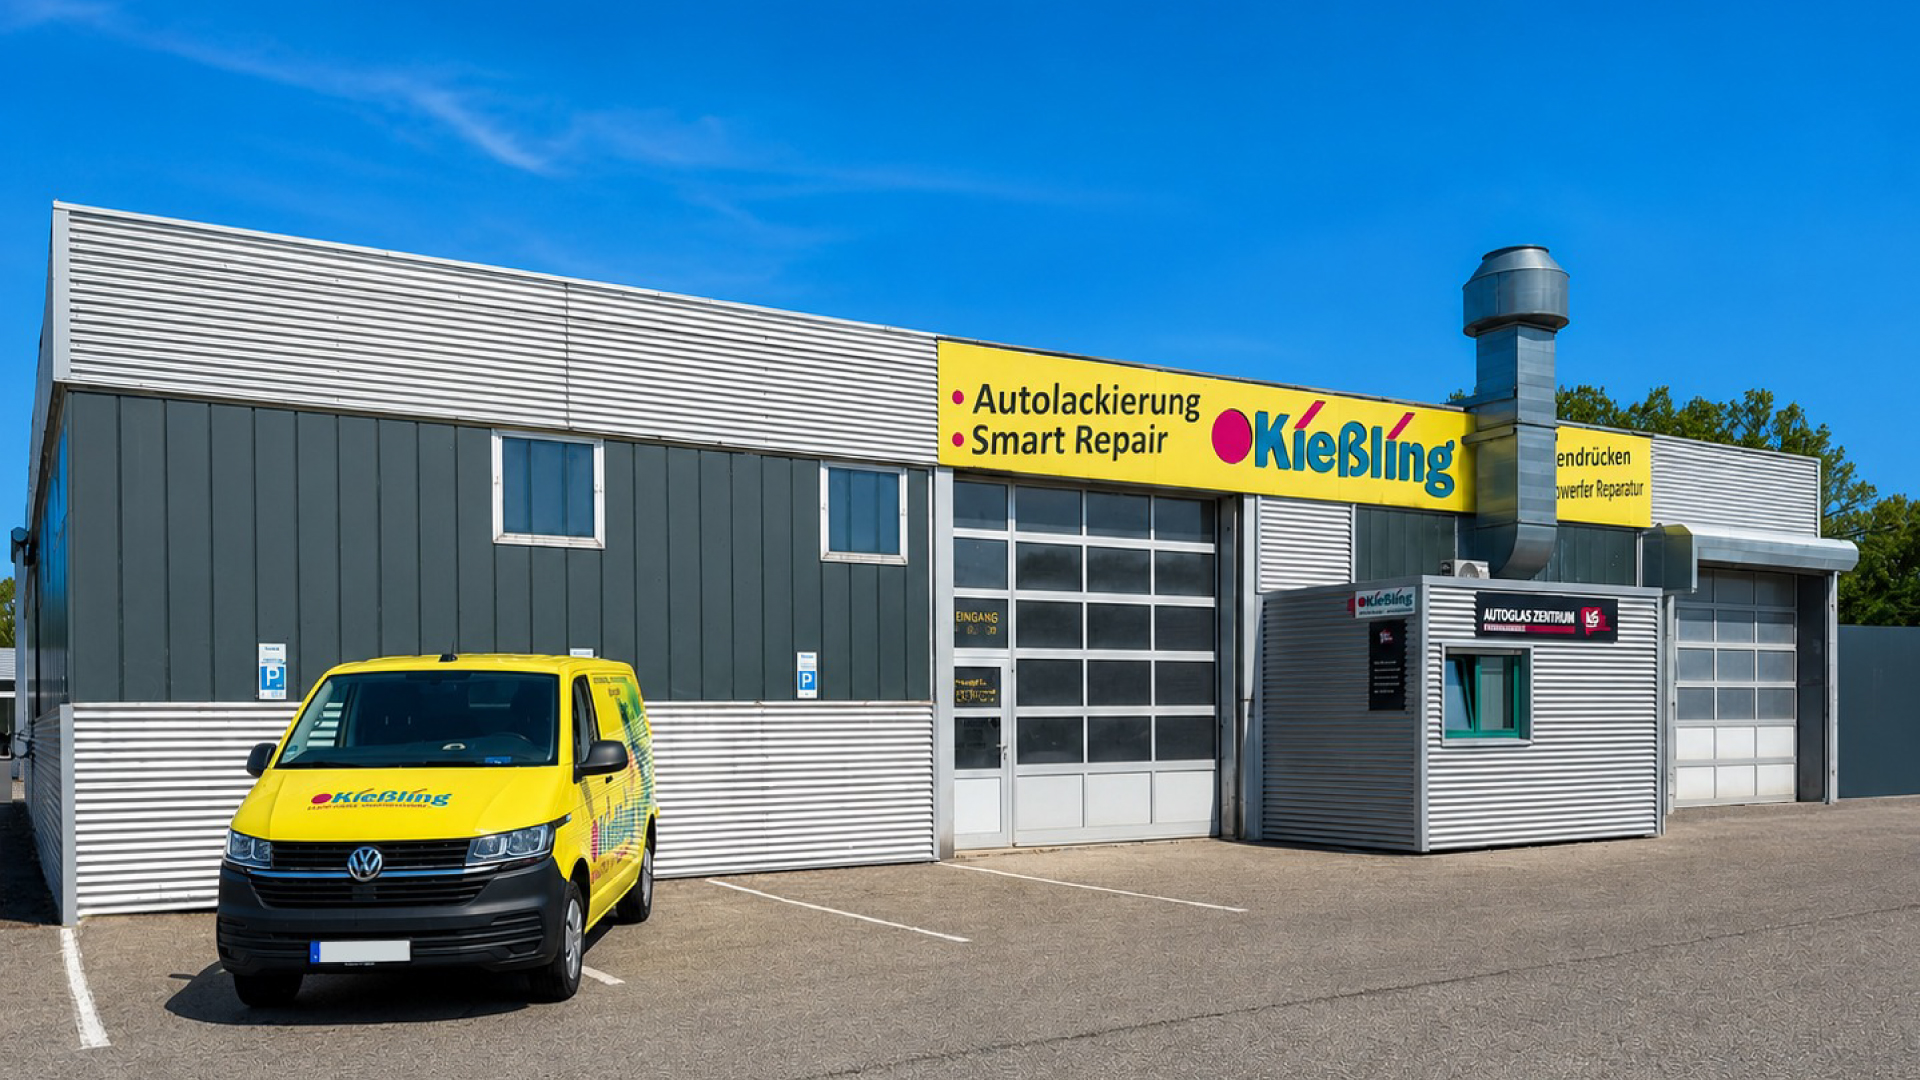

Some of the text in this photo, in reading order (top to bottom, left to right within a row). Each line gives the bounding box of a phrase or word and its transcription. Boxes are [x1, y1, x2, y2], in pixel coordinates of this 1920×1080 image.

[972, 383, 1201, 423] Autolackierung
[971, 423, 1169, 461] Smart Repair
[1556, 446, 1631, 467] endrücken
[1596, 479, 1644, 501] Reparatur
[955, 611, 999, 624] EINGANG
[1483, 608, 1575, 624] AUTOGLAS ZENTRUM
[266, 666, 280, 687] P
[802, 673, 813, 688] P
